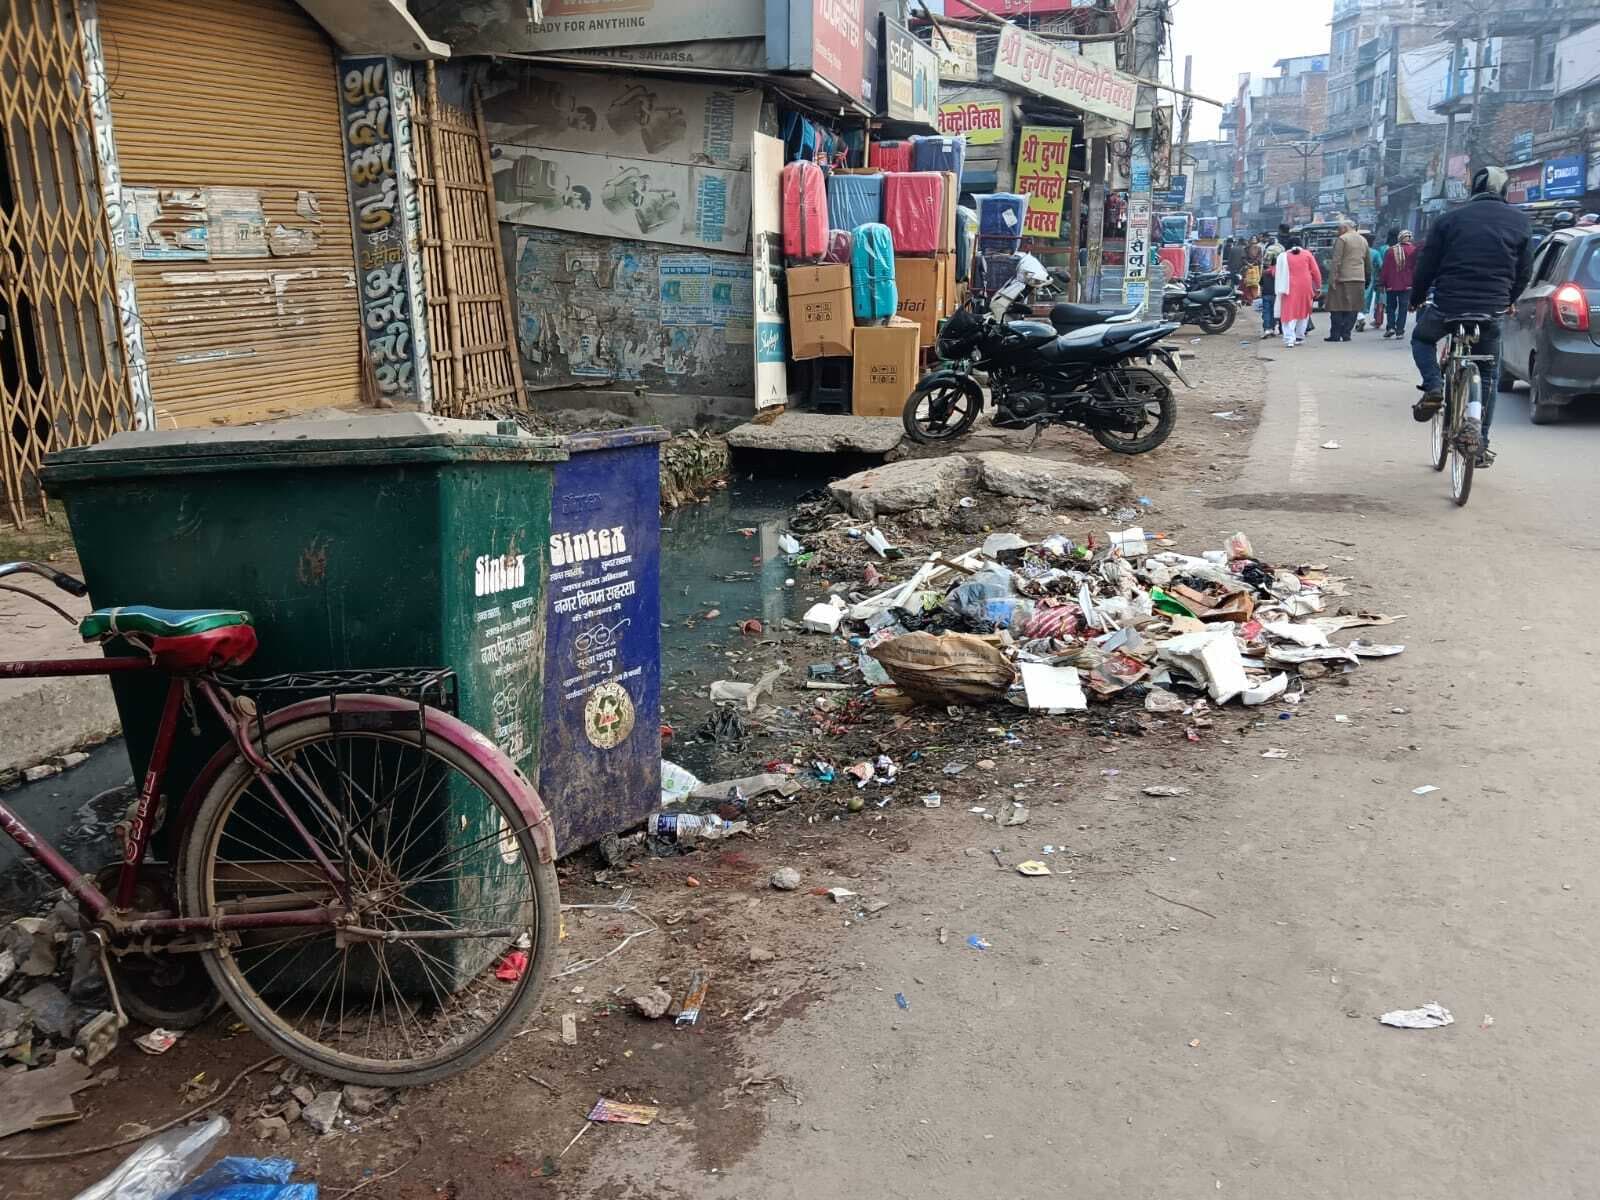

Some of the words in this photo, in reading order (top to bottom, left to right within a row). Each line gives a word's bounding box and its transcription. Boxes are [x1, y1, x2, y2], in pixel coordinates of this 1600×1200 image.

[526, 20, 560, 34] READY
[564, 21, 585, 32] FOR
[589, 17, 645, 30] ANYTHING
[639, 49, 694, 63] SAHARSA
[1001, 31, 1021, 67] श्री
[1023, 134, 1039, 162] श्री
[1041, 136, 1068, 172] दुर्गा
[702, 175, 717, 242] ADVENTURE
[897, 299, 927, 312] afari
[550, 526, 626, 566] Sintex
[475, 554, 525, 596] Sintex
[554, 596, 577, 614] नगर
[577, 589, 605, 609] निगम
